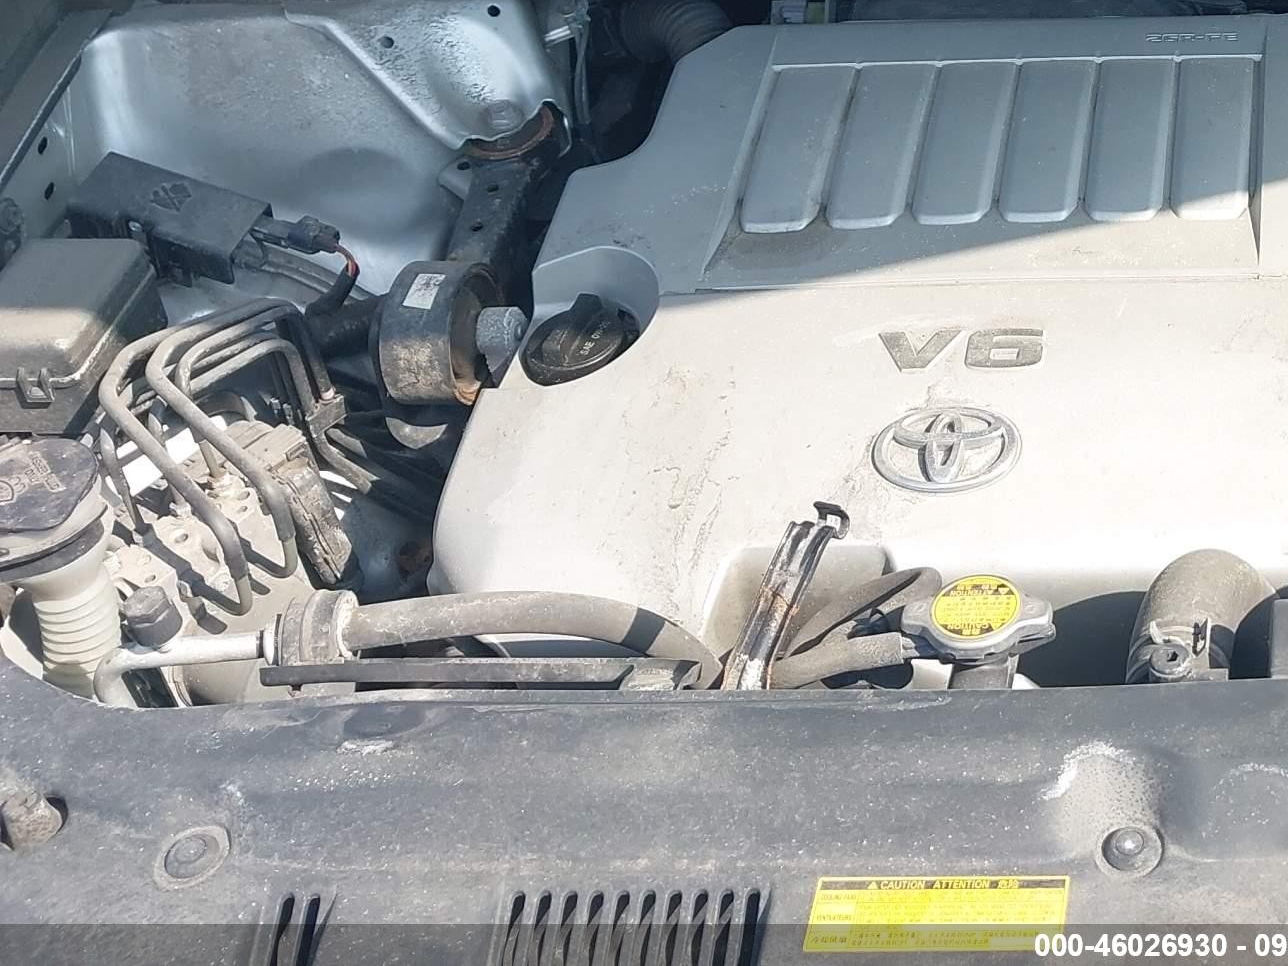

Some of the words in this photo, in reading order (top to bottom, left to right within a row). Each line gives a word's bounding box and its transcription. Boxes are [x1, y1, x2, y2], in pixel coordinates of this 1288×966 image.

[1145, 33, 1239, 42] 2GR-FE
[579, 341, 596, 356] SAE
[878, 328, 1044, 372] V6
[946, 622, 990, 630] CAUTION
[880, 880, 926, 890] CAUTION
[932, 880, 990, 890] ATTENTION
